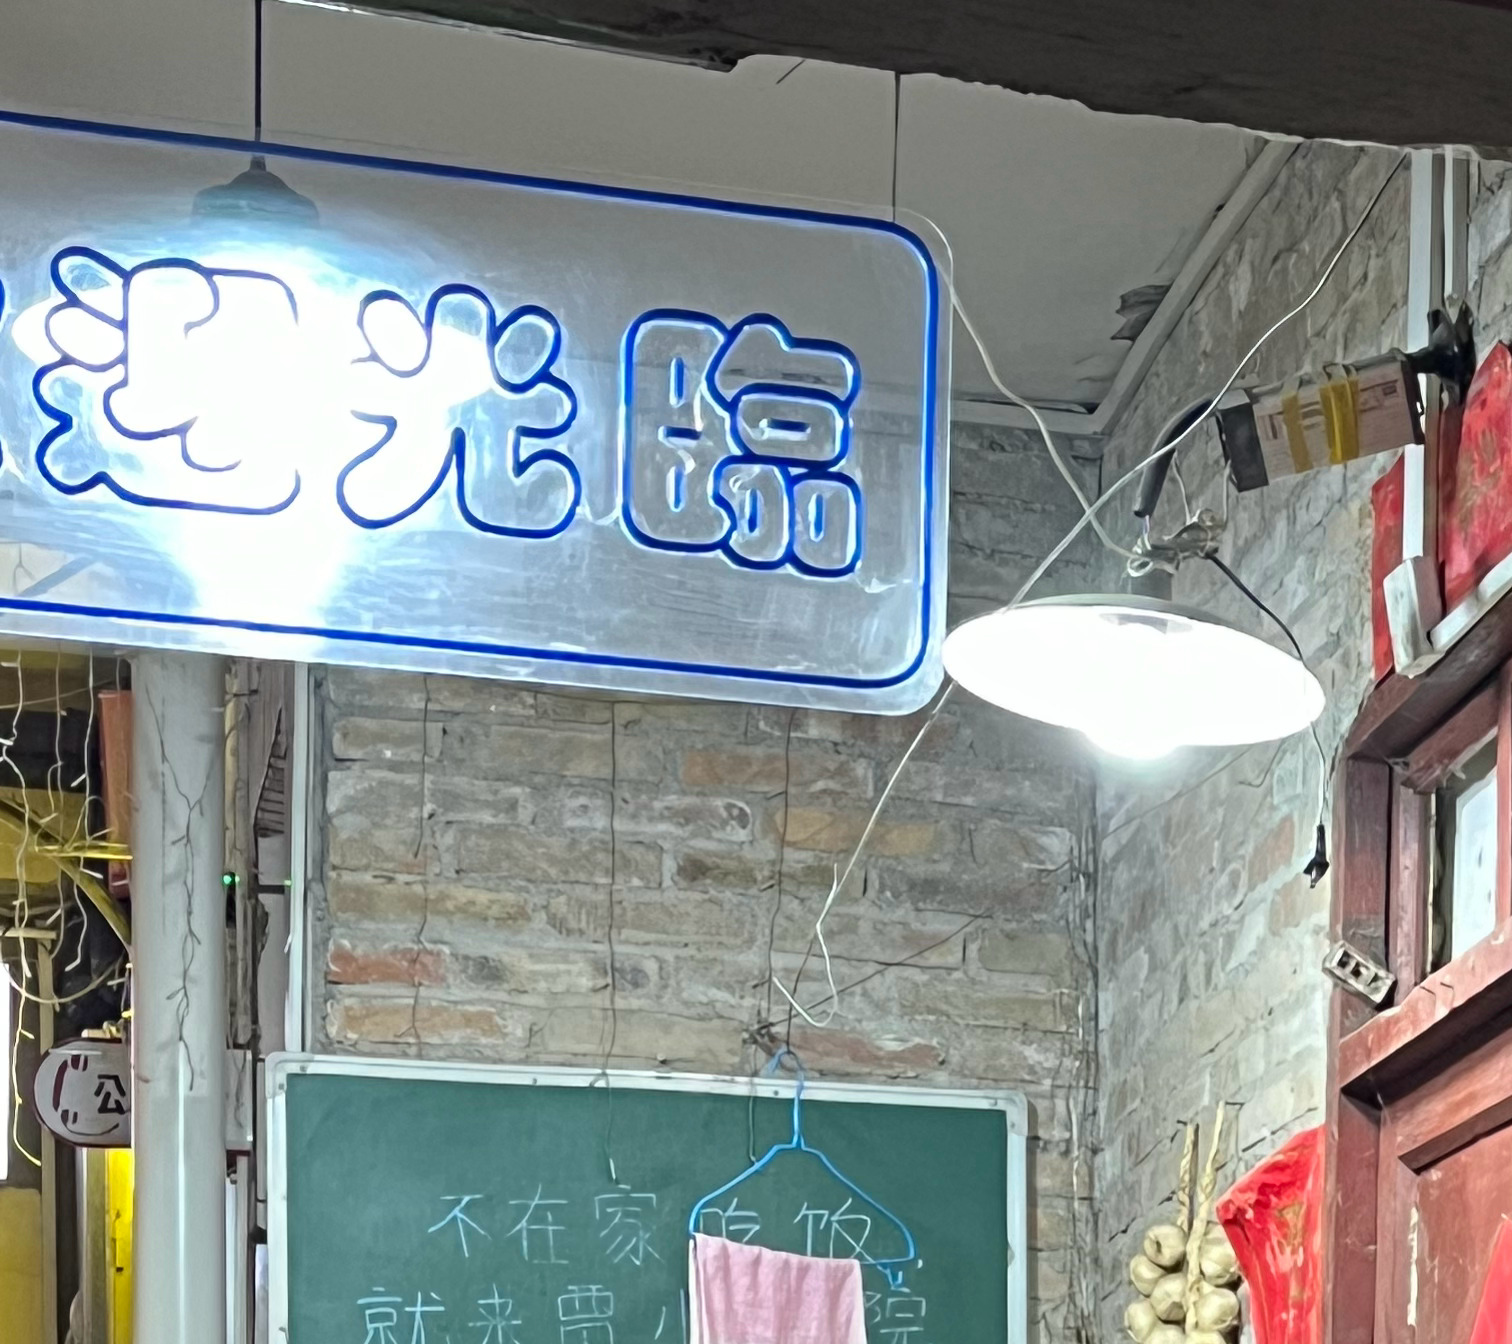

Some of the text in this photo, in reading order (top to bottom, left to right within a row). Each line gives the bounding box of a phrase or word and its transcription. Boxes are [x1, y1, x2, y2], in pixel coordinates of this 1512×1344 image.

[0, 244, 863, 578] 迎光臨
[94, 1074, 126, 1115] 公
